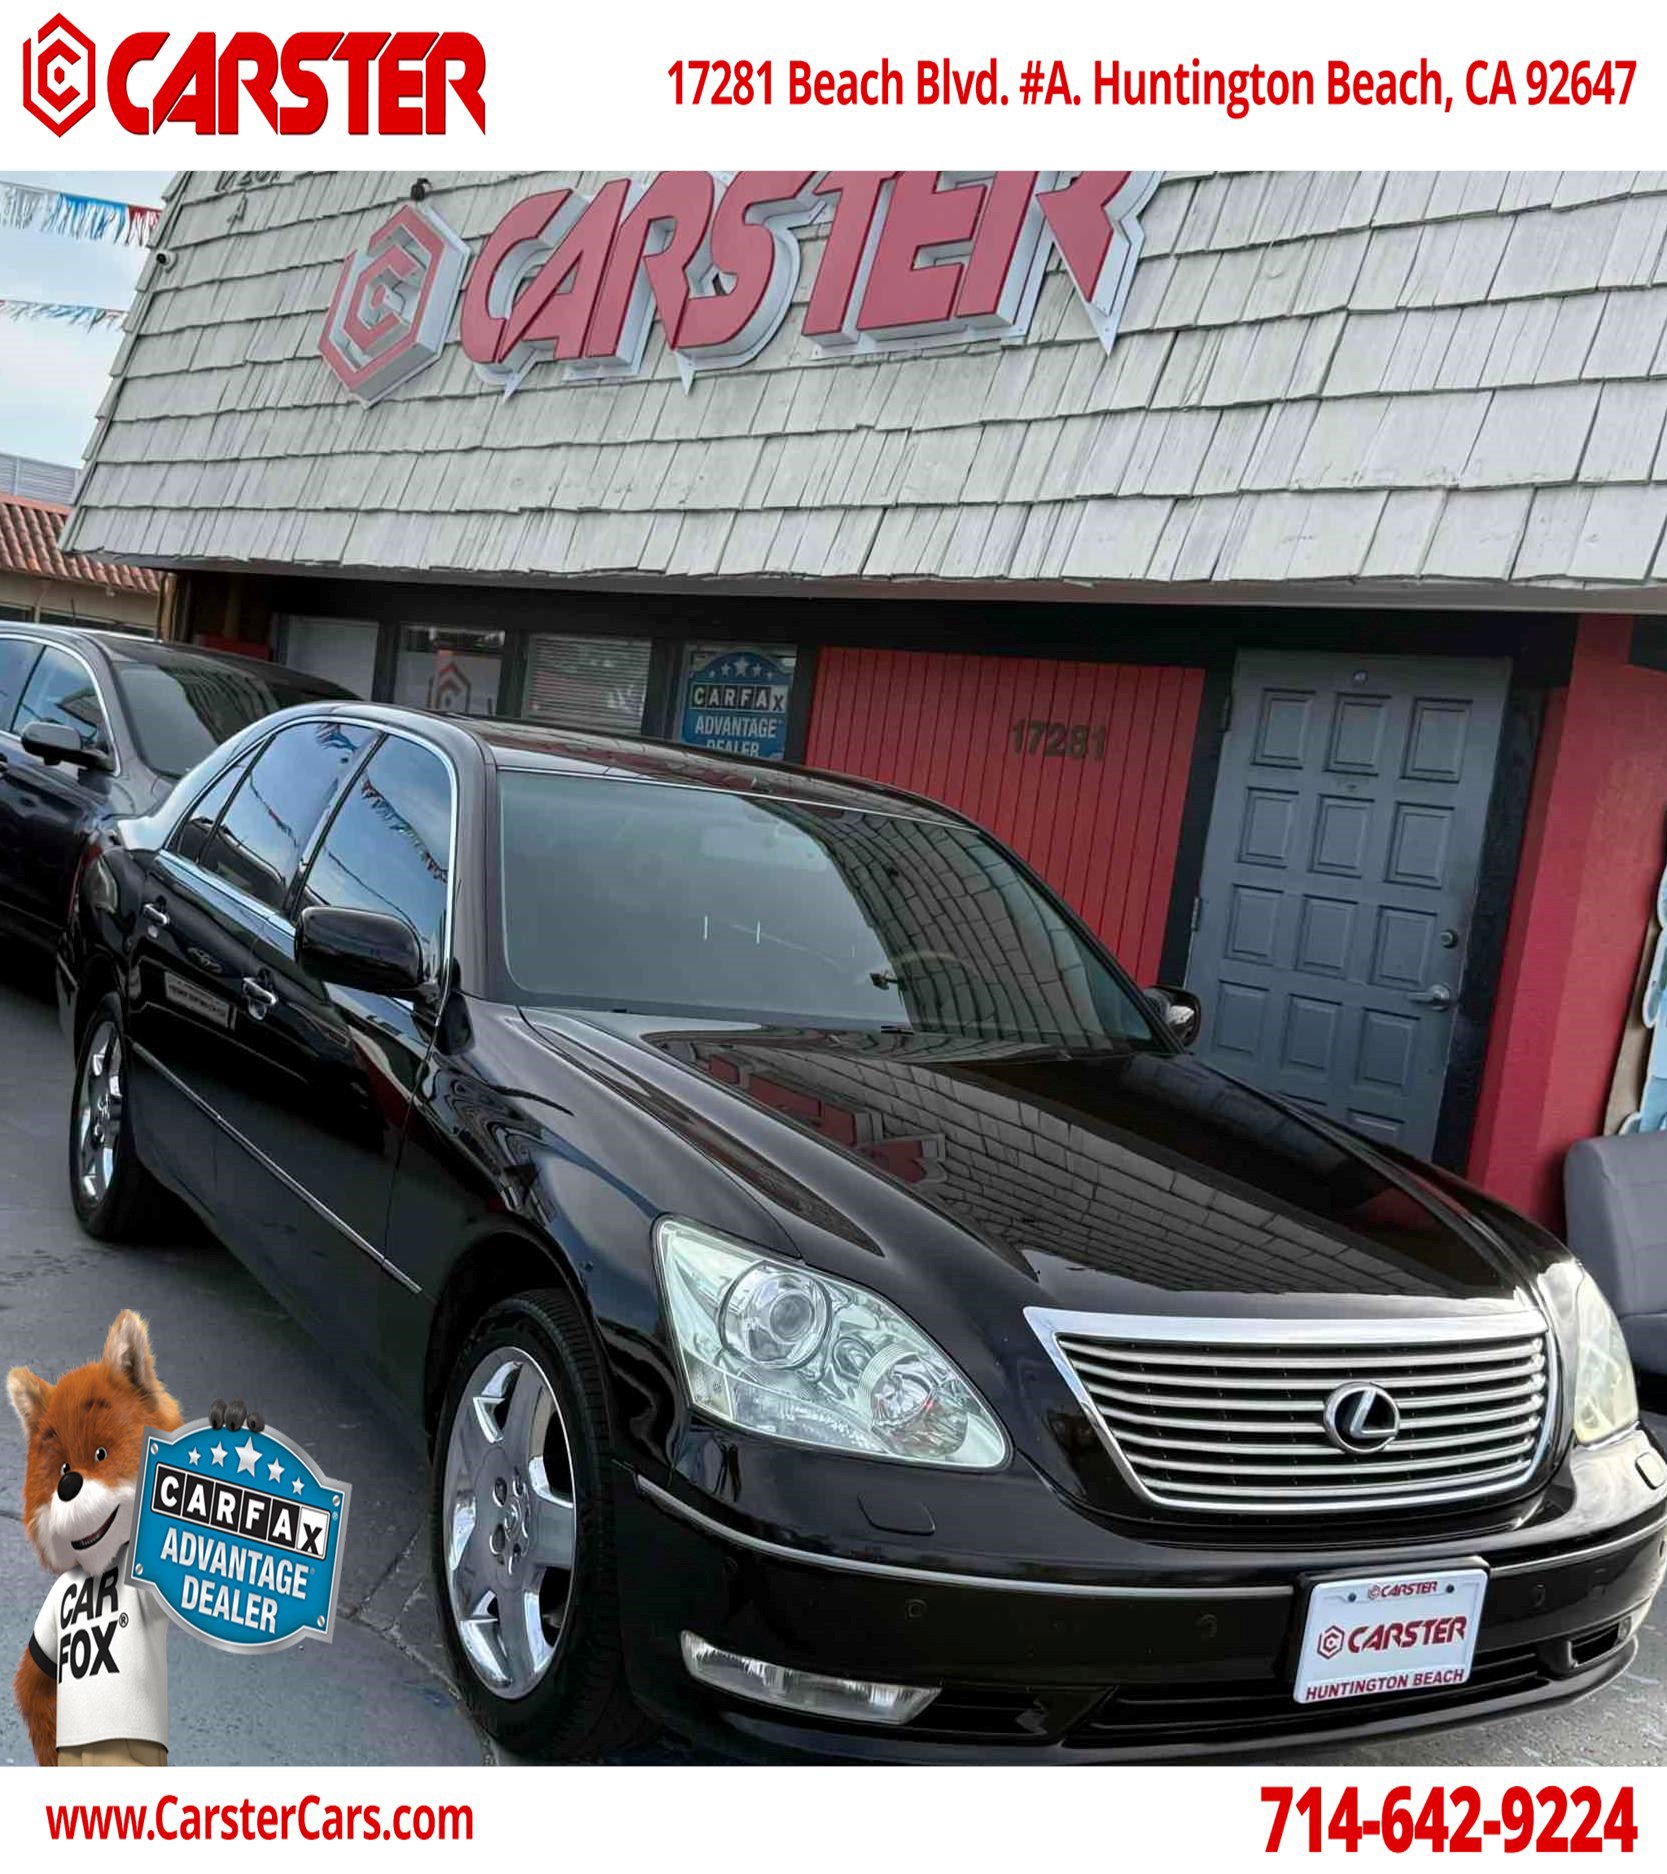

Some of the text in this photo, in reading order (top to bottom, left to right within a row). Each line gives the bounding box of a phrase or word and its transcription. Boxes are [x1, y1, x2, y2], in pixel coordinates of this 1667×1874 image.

[461, 171, 1143, 363] CARSTER
[694, 686, 785, 712] CARFAX
[695, 715, 778, 739] ADVANTAGE
[1012, 719, 1107, 761] 17281
[1380, 1581, 1438, 1598] CARSTER
[1347, 1616, 1467, 1654] CARSTER
[1305, 1669, 1465, 1701] HUNTINGTON BEACH
